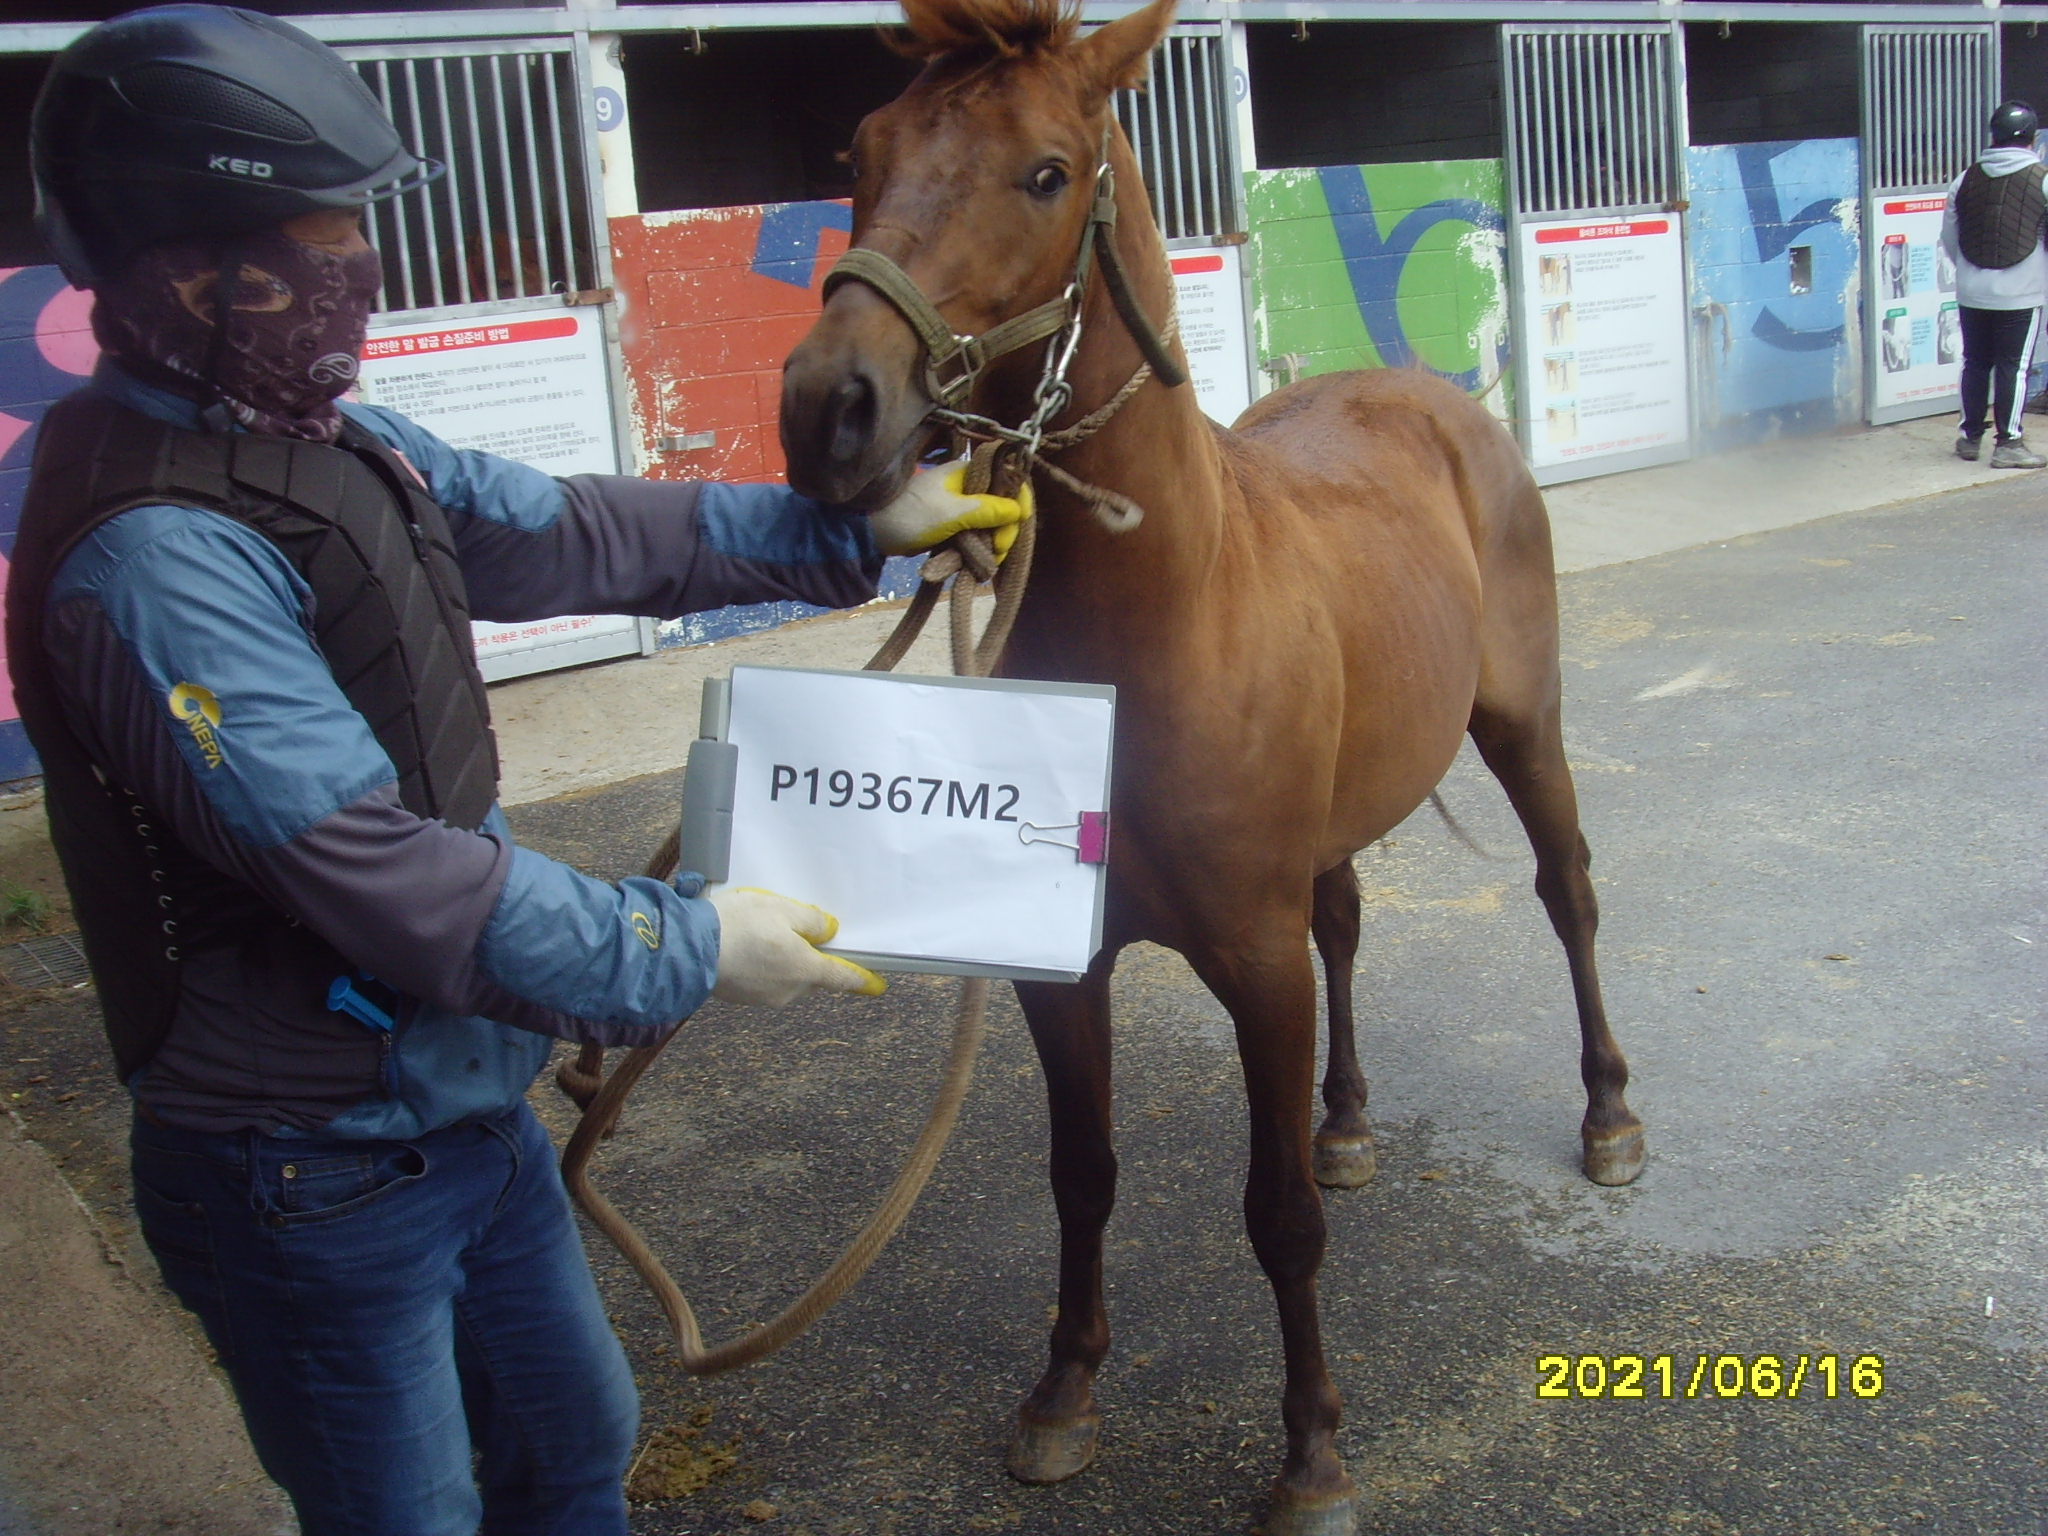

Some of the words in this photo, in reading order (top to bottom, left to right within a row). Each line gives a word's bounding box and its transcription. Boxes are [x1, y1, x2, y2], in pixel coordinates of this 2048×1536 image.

[595, 96, 612, 122] 9
[208, 154, 273, 178] KED
[366, 341, 399, 355] 안전한
[402, 339, 414, 350] 말
[443, 330, 485, 346] 손질준비
[488, 328, 509, 341] 방법
[491, 631, 519, 644] 착용은
[521, 625, 548, 639] 선택이
[550, 621, 569, 632] 아닌
[185, 713, 223, 770] NEPA
[770, 763, 1021, 823] P19367M2
